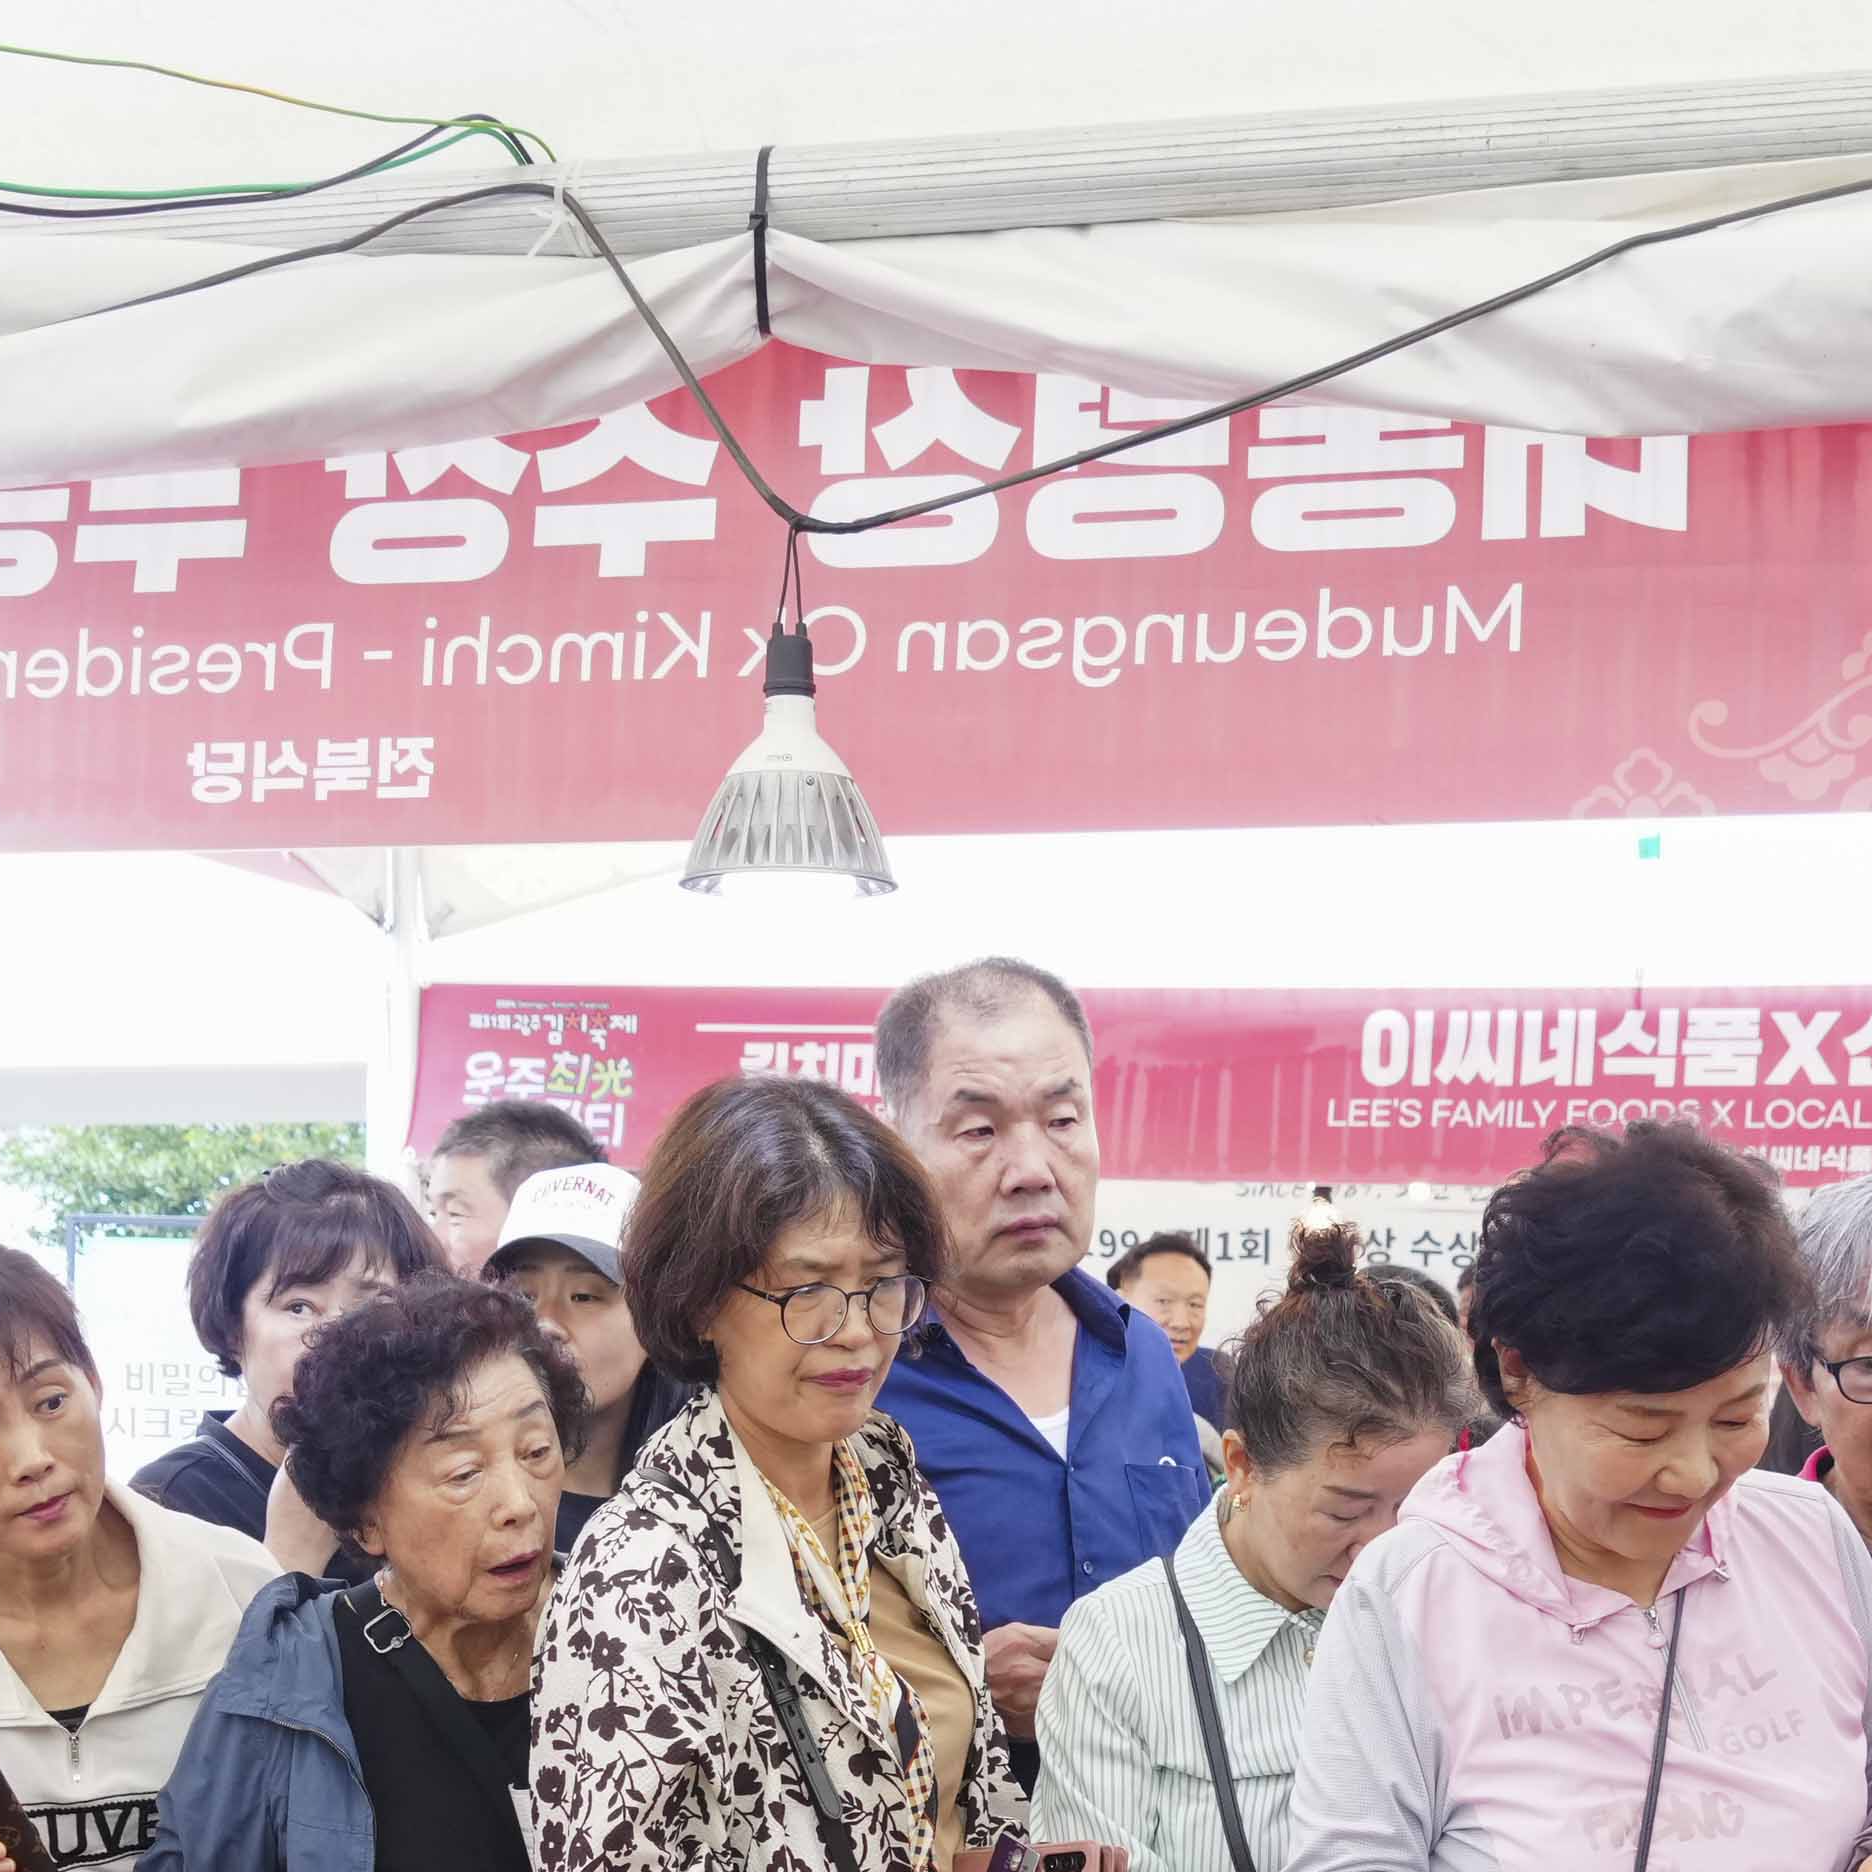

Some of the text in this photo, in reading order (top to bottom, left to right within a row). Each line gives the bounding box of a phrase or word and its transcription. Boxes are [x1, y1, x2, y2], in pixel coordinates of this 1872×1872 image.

[1327, 1098, 1424, 1129] LEE'S
[1431, 1098, 1558, 1129] FAMILY
[1709, 1099, 1736, 1129] X
[1494, 1653, 1778, 1740] IMPERAL
[1720, 1708, 1806, 1756] GOLF
